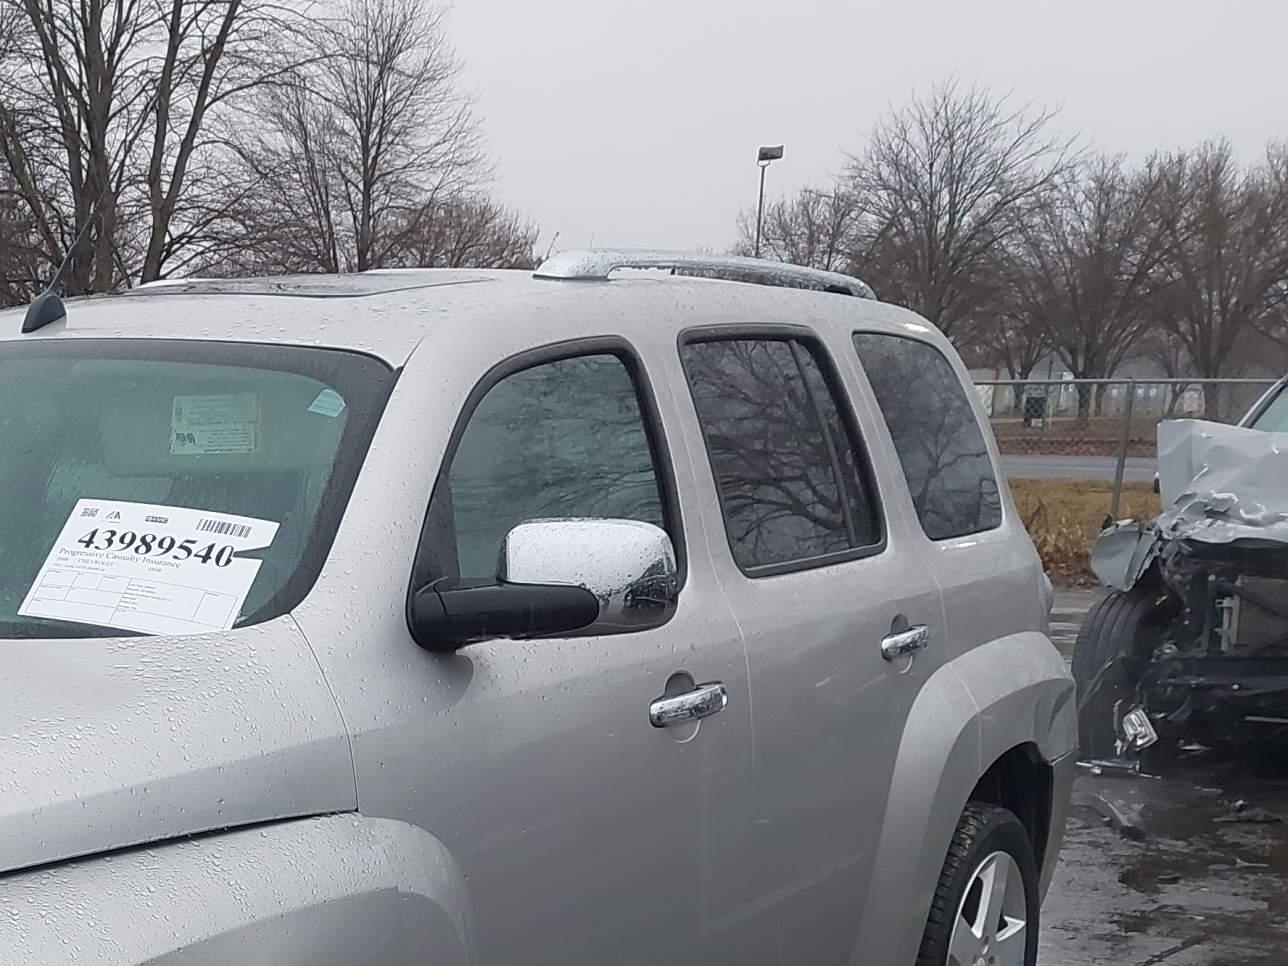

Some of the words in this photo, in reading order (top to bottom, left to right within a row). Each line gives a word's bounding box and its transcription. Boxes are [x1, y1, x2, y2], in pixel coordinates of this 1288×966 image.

[58, 547, 105, 559] Progressive
[105, 552, 141, 563] Casualty
[141, 556, 182, 569] Insurance
[77, 527, 235, 568] 43989540
